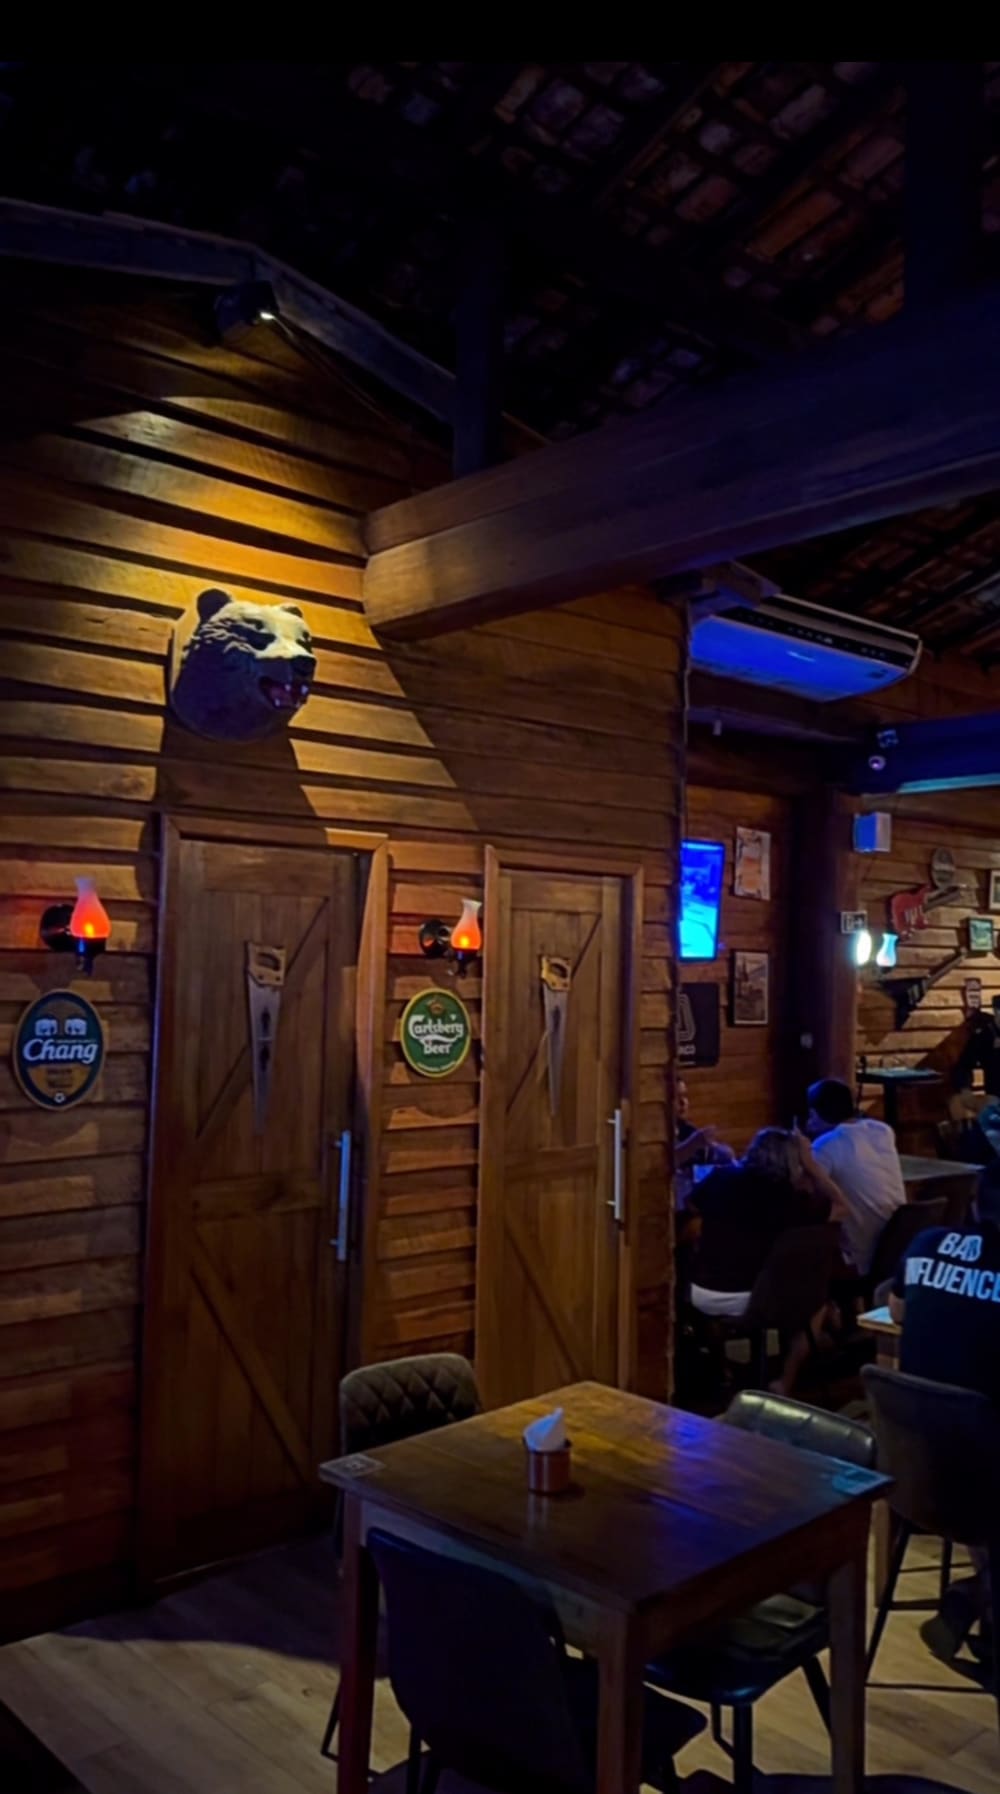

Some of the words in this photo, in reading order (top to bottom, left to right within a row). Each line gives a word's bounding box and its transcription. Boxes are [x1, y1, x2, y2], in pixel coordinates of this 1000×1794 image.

[408, 1014, 464, 1042] Carlsberg
[22, 1038, 99, 1064] Chang
[421, 1037, 453, 1054] Beer
[937, 1231, 983, 1262] BAD
